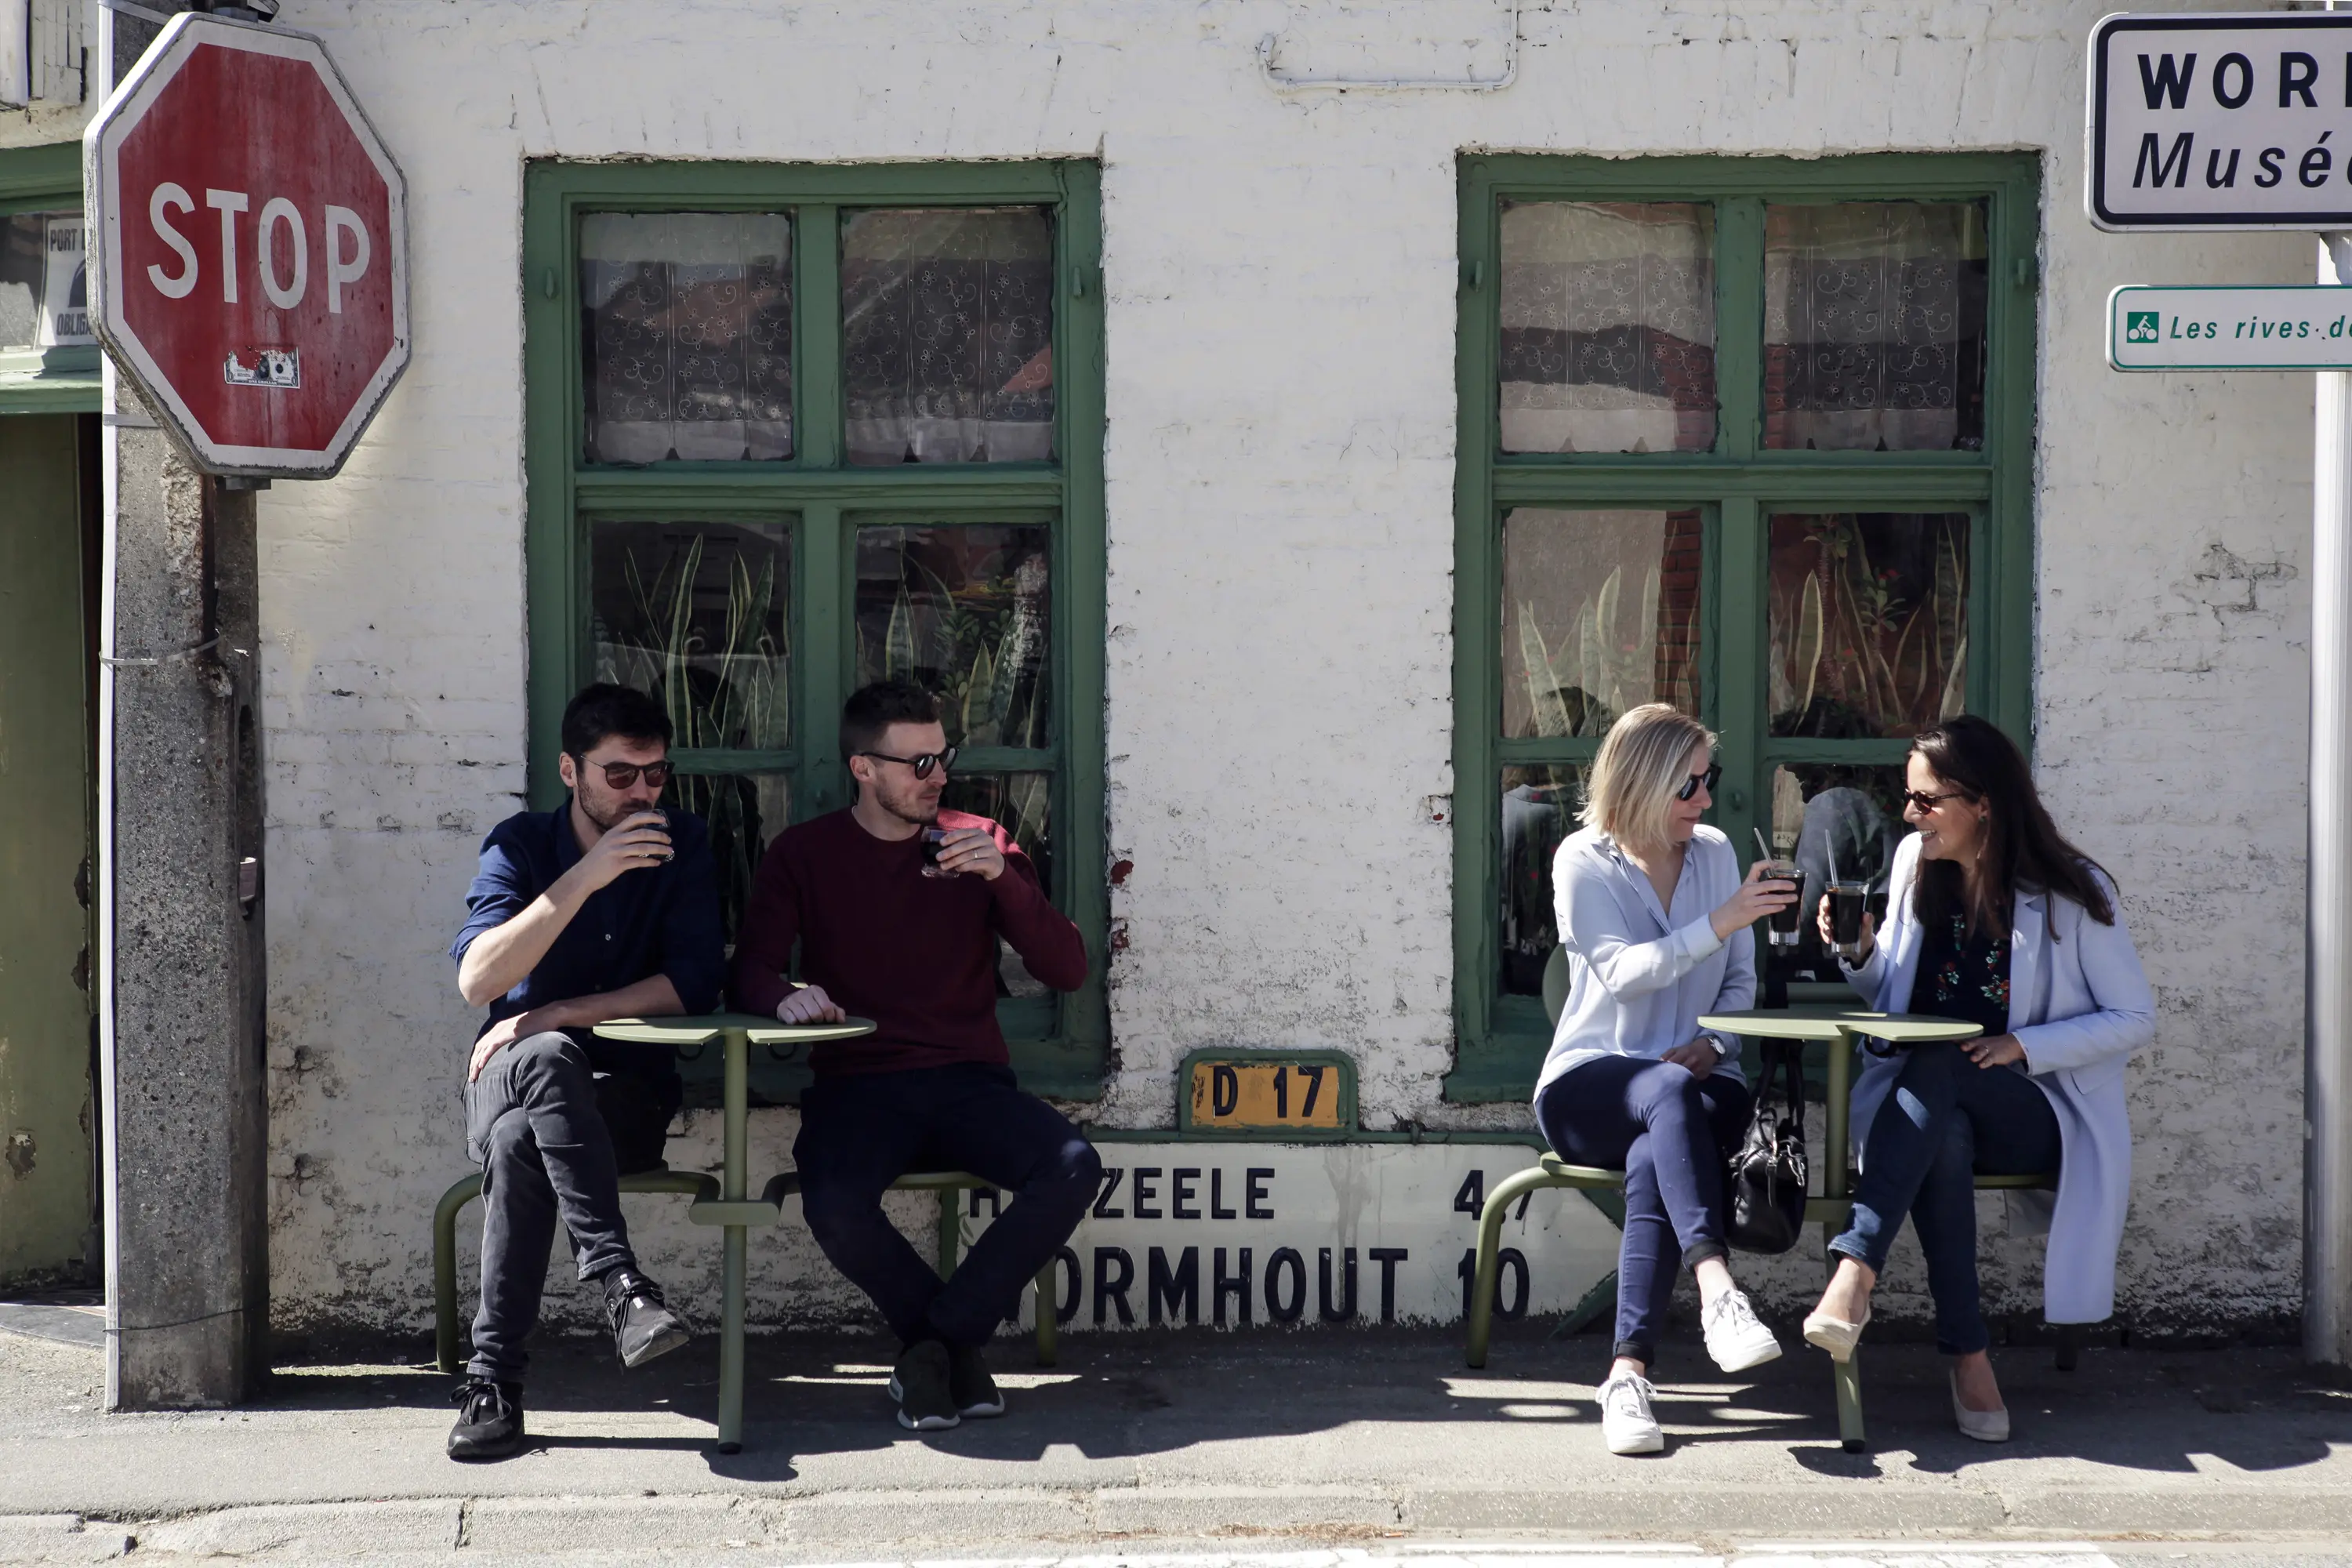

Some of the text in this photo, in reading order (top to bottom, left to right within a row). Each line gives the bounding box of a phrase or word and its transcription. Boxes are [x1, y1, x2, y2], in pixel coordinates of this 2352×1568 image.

[2132, 130, 2352, 189] Musé
[49, 228, 78, 252] PORT
[147, 181, 371, 314] STOP
[2169, 314, 2352, 339] Les rives d
[1212, 1065, 1324, 1119] D 17
[970, 1167, 1276, 1220] HZEELE
[967, 1245, 1530, 1323] ORMHOUT 10
